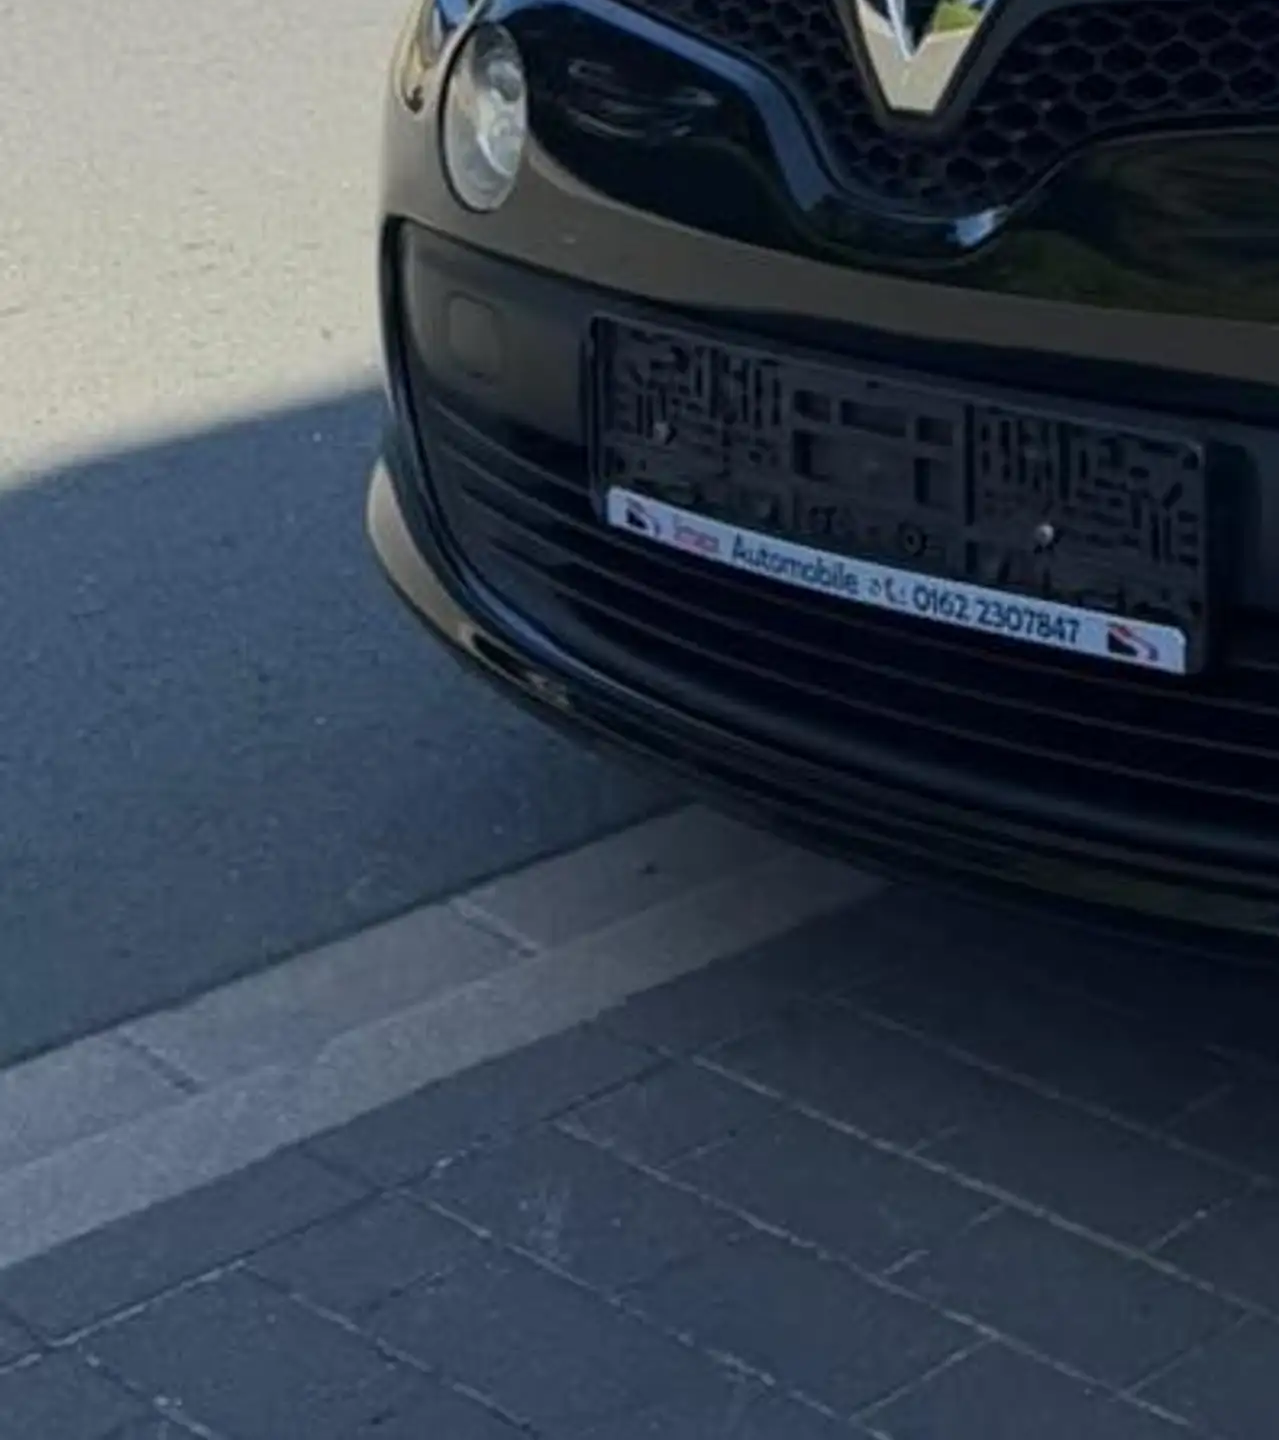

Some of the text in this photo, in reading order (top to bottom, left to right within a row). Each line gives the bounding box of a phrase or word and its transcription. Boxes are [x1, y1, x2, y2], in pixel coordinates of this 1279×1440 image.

[732, 532, 859, 596] Automobile
[912, 583, 972, 620] 0162
[976, 598, 1081, 644] 2307847
